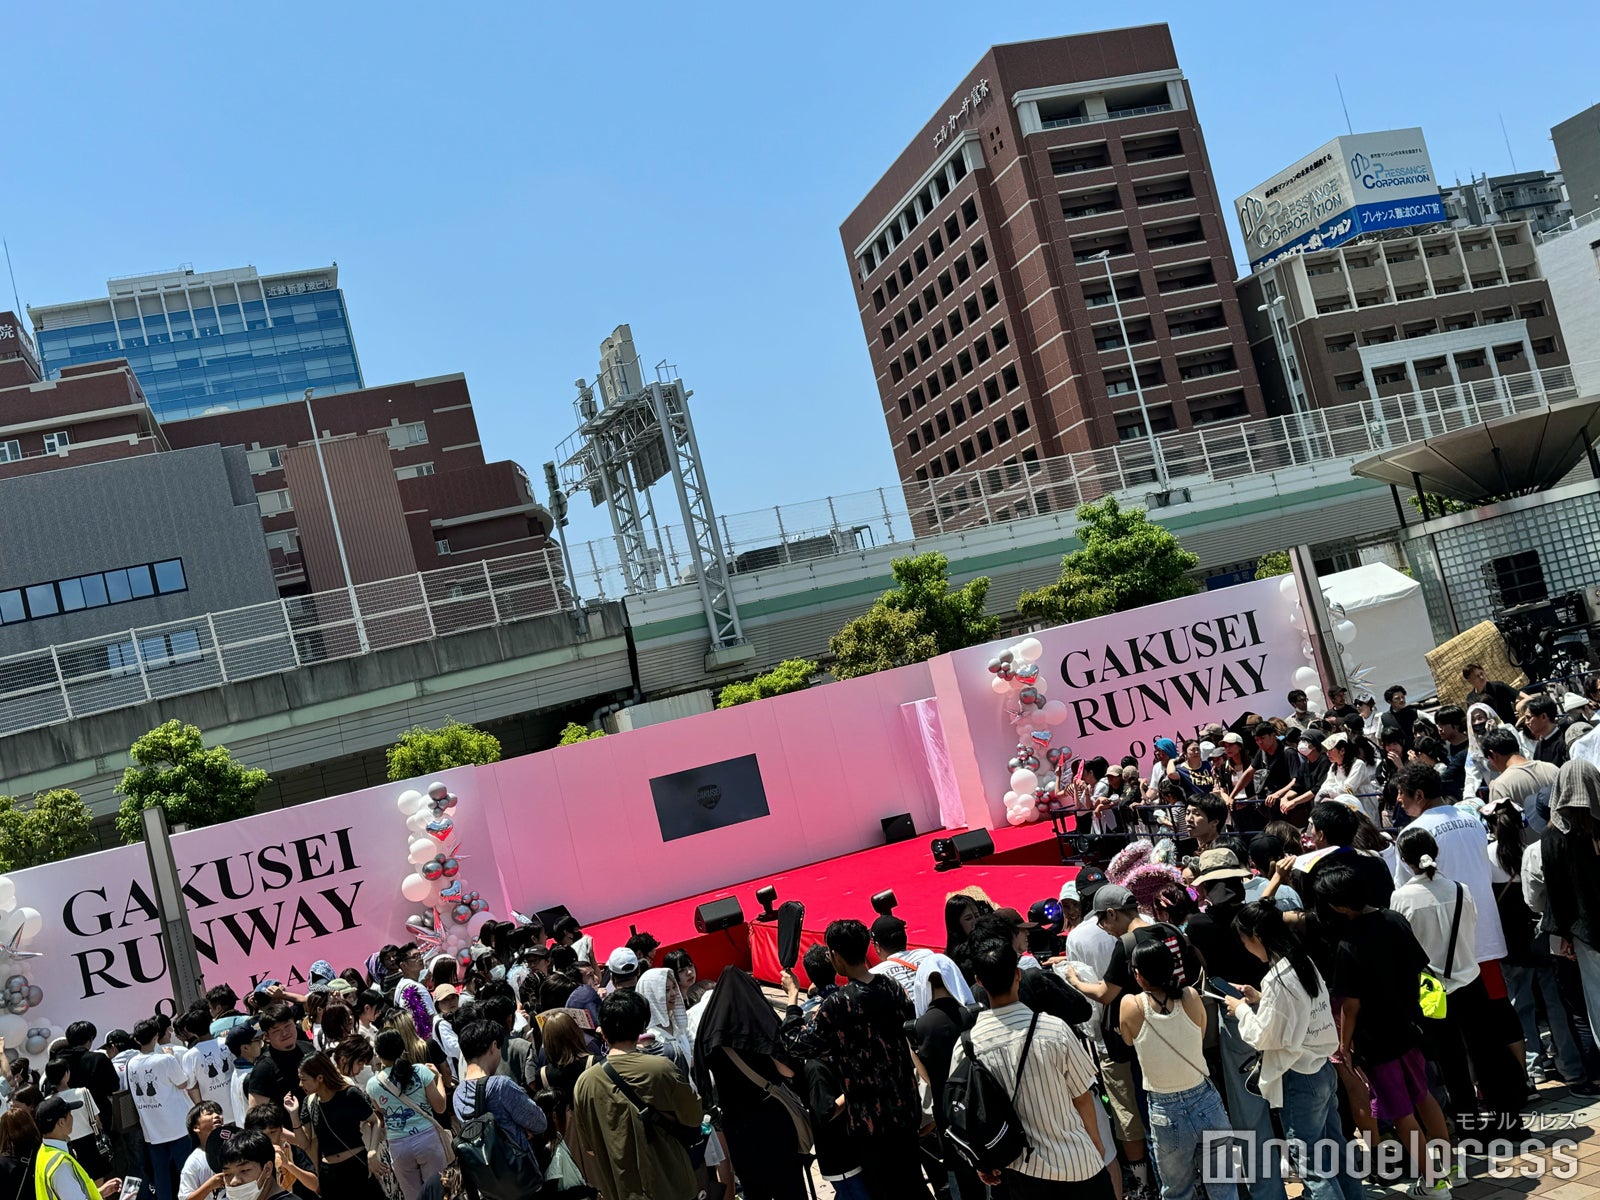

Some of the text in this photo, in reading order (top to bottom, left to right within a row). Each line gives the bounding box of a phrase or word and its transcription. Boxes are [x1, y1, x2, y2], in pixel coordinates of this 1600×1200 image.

[1060, 609, 1265, 689] GAKUSEI
[1069, 653, 1270, 739] RUNWAY
[62, 826, 361, 937] GAKUSEI
[71, 880, 364, 1000] RUNWAY
